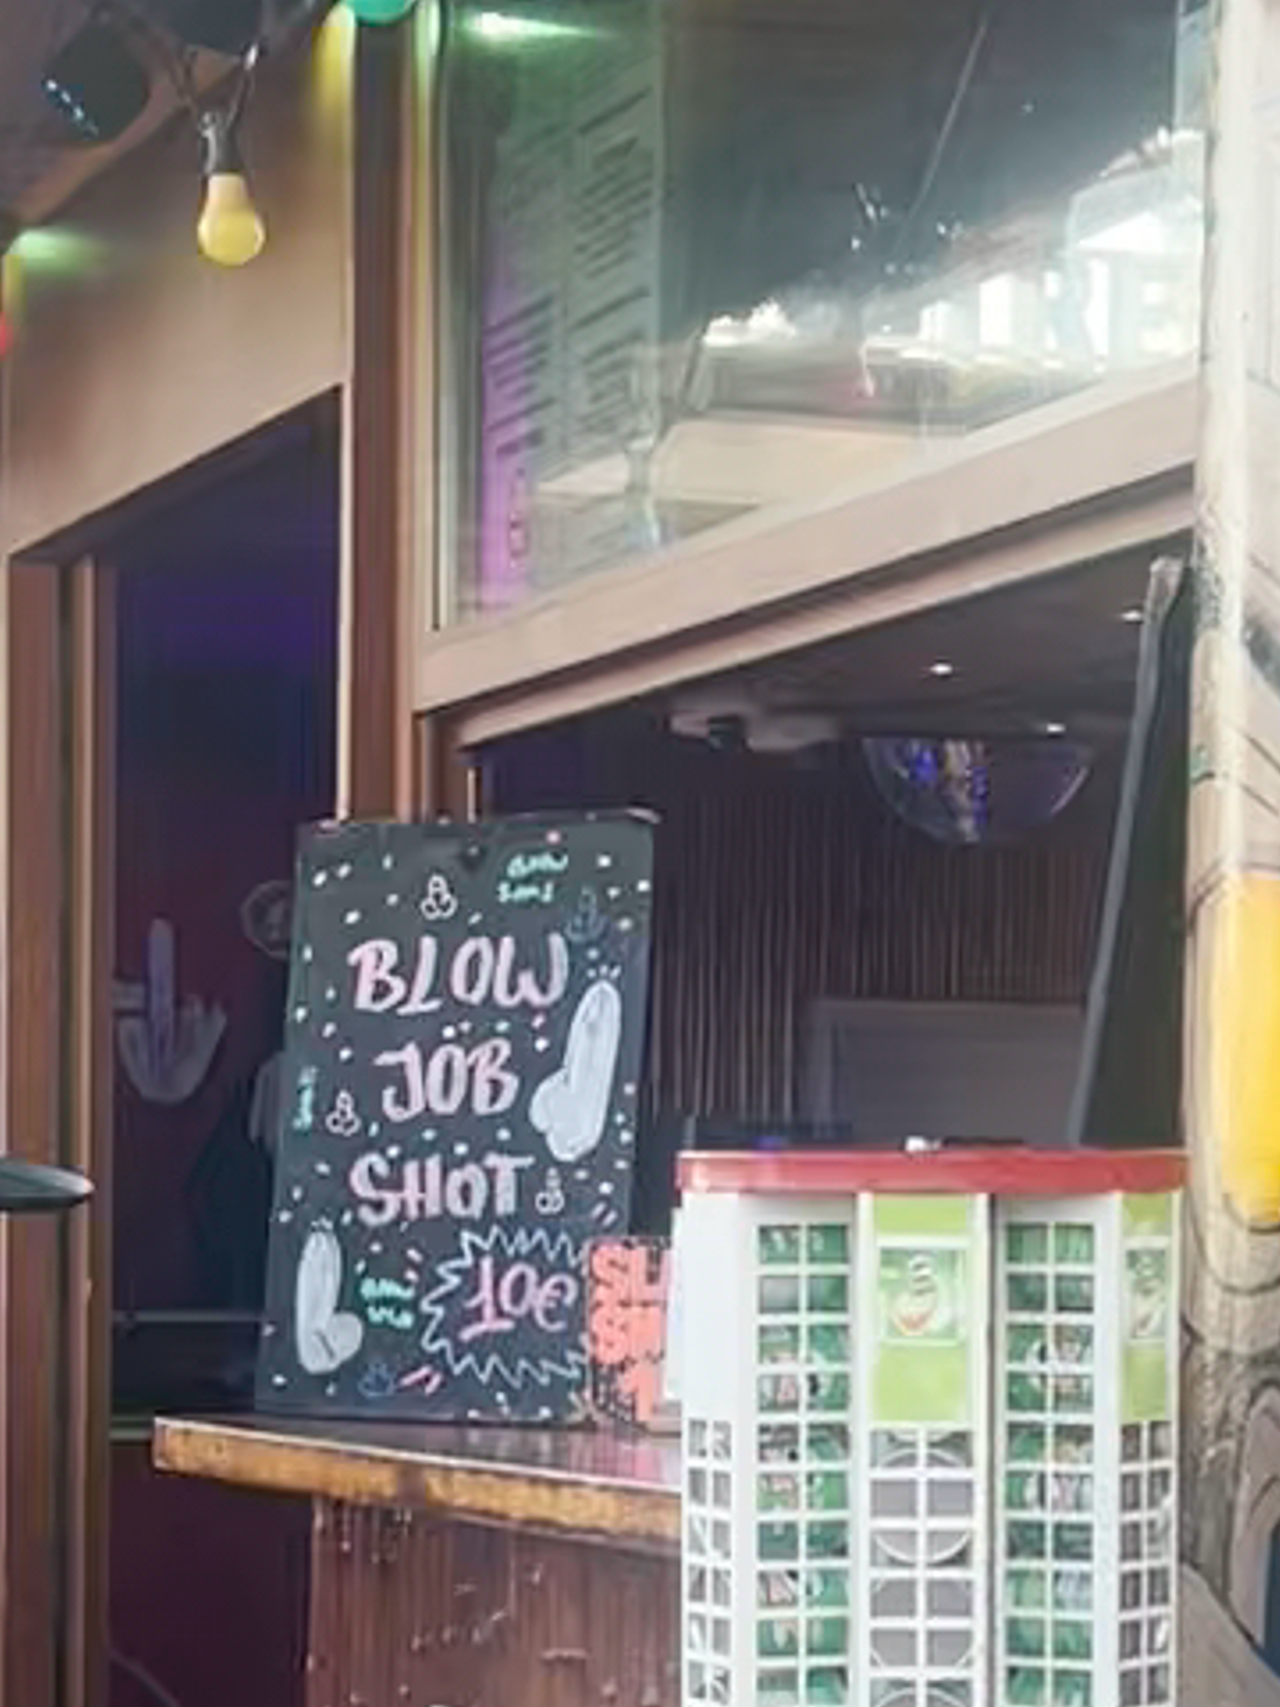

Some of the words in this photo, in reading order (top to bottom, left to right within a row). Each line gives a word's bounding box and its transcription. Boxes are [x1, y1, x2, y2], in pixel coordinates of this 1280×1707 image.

[346, 931, 570, 1015] BLOW
[374, 1038, 520, 1122] JOB
[349, 1152, 535, 1226] SHOT
[459, 1255, 578, 1341] 10€
